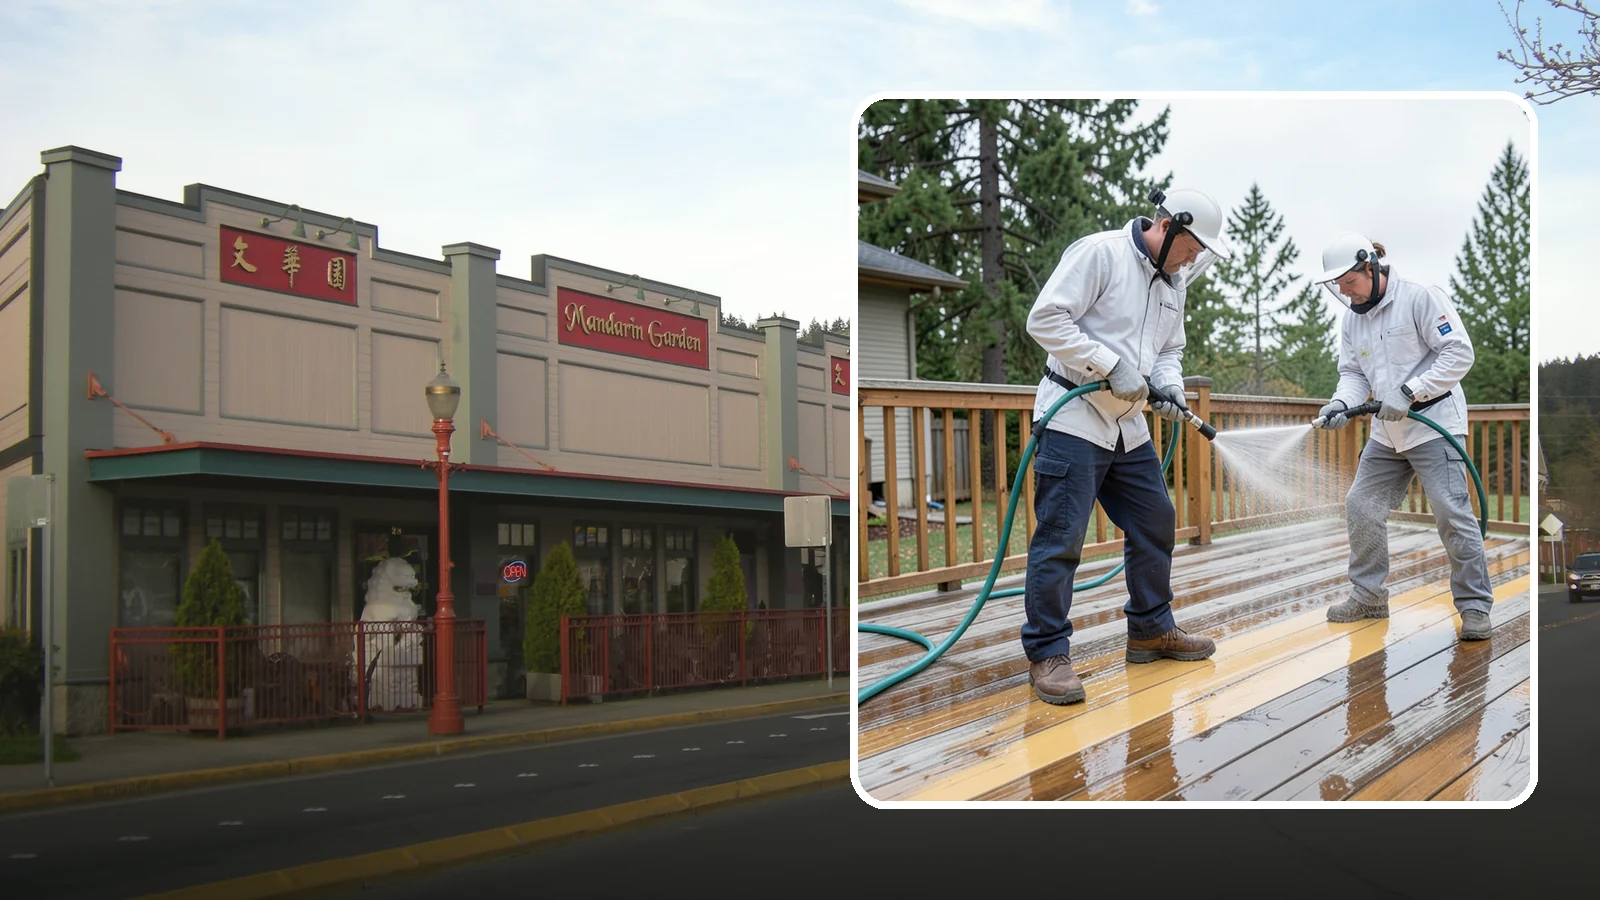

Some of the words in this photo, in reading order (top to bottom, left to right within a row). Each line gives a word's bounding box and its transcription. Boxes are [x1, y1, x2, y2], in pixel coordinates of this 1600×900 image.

[231, 235, 346, 291] 文華園
[564, 302, 644, 341] Mandarin
[647, 320, 702, 352] Garden
[503, 565, 527, 578] OPEN
